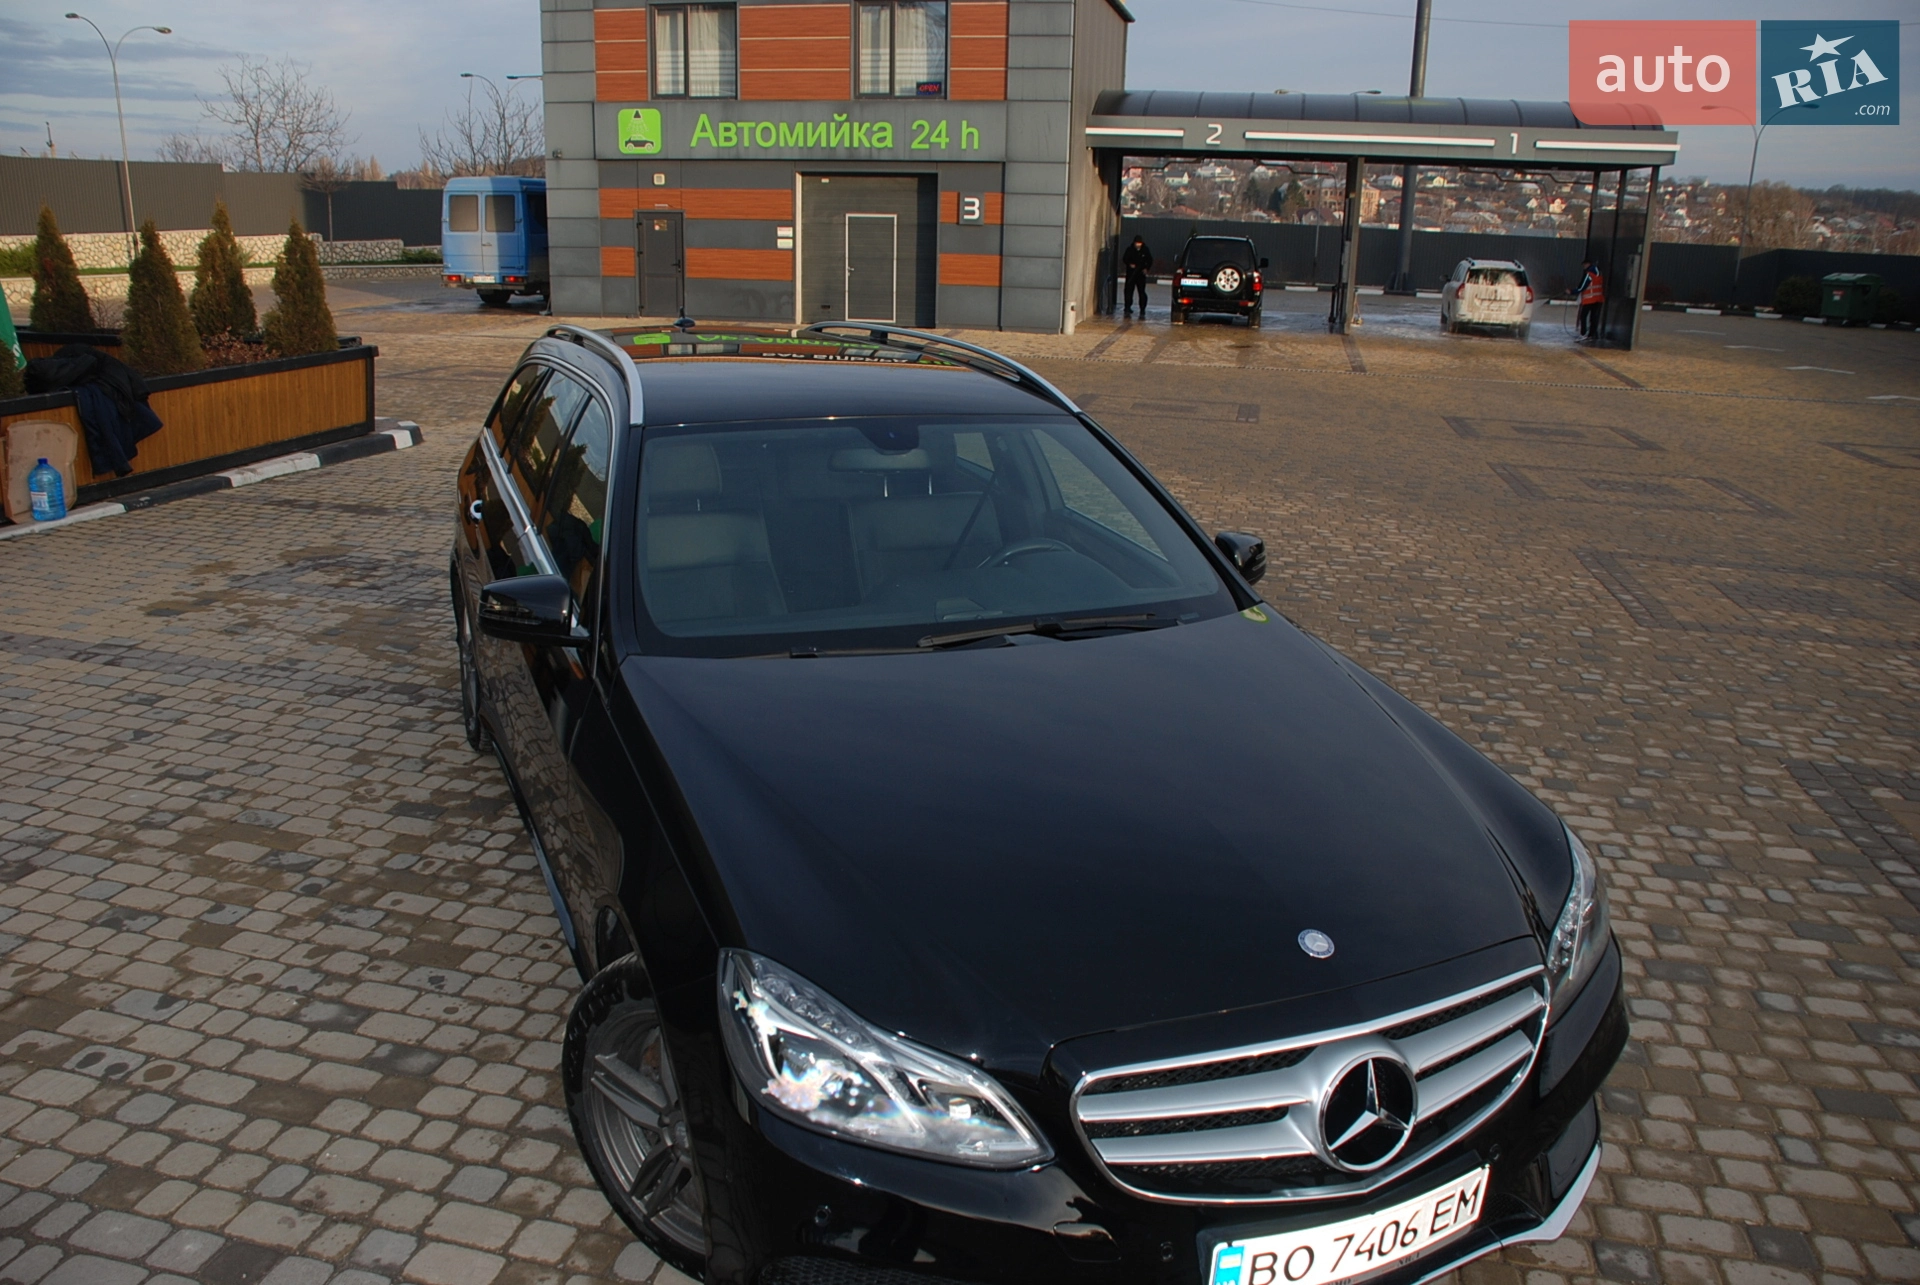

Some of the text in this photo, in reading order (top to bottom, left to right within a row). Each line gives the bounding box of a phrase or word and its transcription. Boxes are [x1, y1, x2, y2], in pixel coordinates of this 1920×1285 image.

[690, 113, 980, 150] Автомийка 24 h
[1206, 123, 1223, 146] 2
[1509, 132, 1521, 155] 1
[963, 197, 980, 219] 3
[1330, 1209, 1419, 1273] 7406
